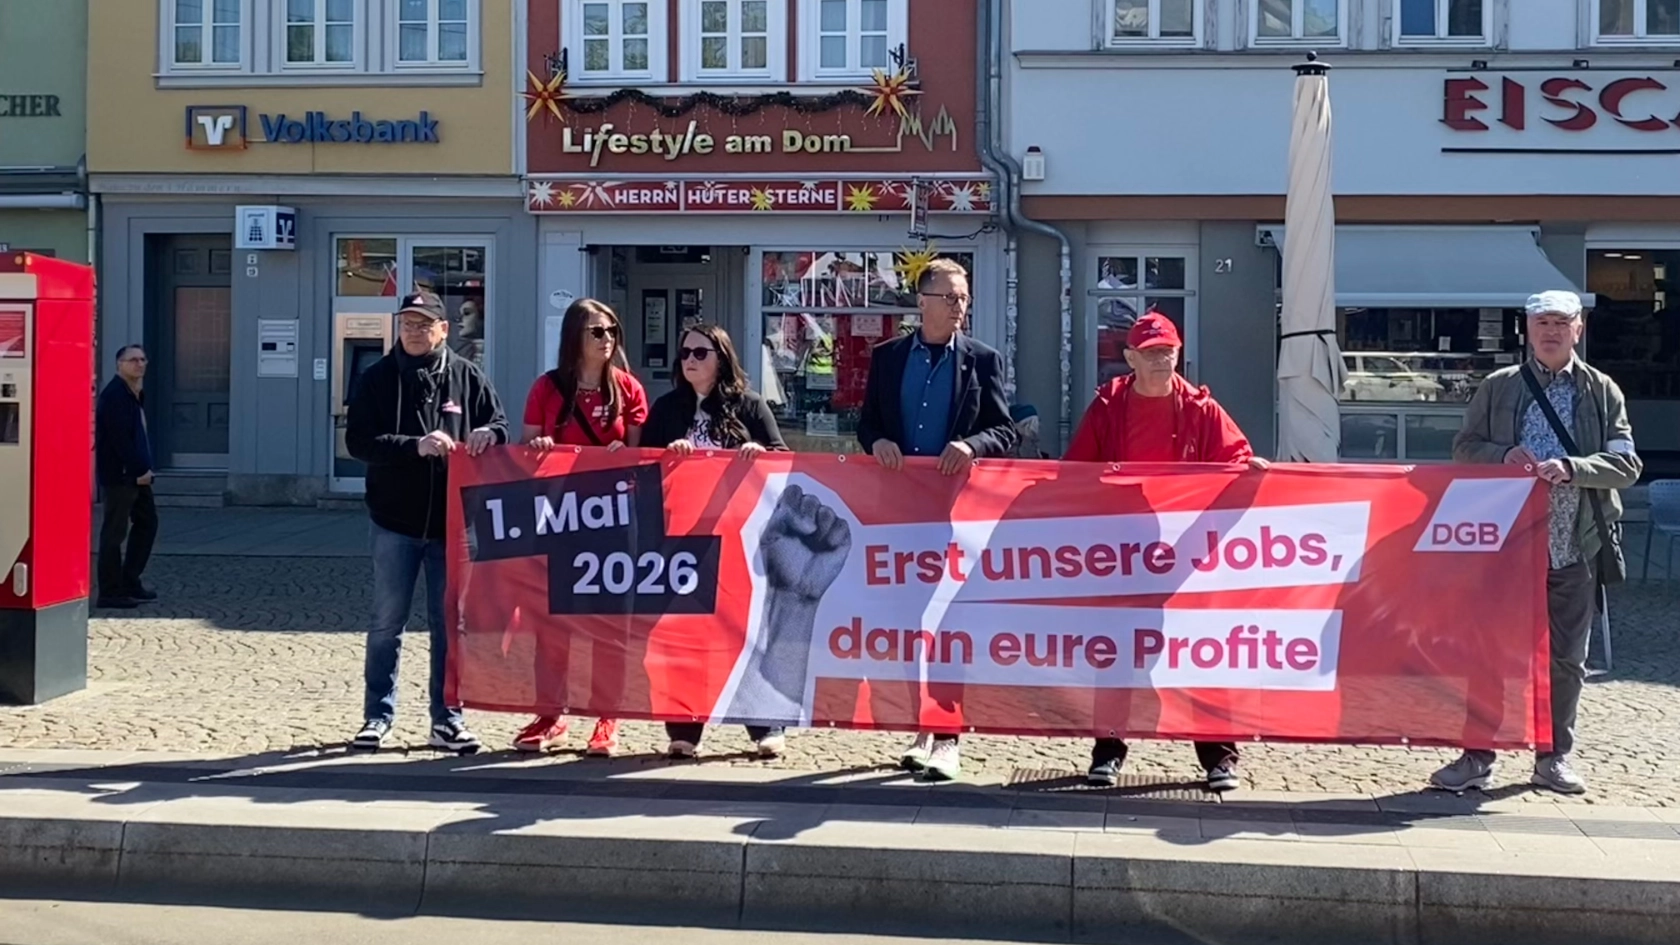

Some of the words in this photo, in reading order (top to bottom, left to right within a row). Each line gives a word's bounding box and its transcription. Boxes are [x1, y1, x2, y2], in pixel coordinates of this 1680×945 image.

[1438, 76, 1680, 131] EISC
[258, 110, 440, 144] Volksbank
[562, 119, 715, 167] Lifestyle
[725, 131, 772, 153] am
[782, 129, 851, 153] Dom
[614, 189, 677, 204] HERRN
[688, 185, 750, 204] HÜTER
[765, 188, 836, 204] STERNE
[1215, 258, 1232, 273] 21
[486, 498, 521, 540] 1.
[534, 480, 631, 536] Mai
[864, 541, 968, 586] Erst
[981, 539, 1176, 581] unsere
[1190, 525, 1344, 572] Jobs,
[1432, 522, 1500, 546] DGB
[572, 551, 699, 595] 2026
[827, 616, 973, 664] dann
[988, 632, 1118, 670] eure
[1133, 624, 1319, 671] Profite
